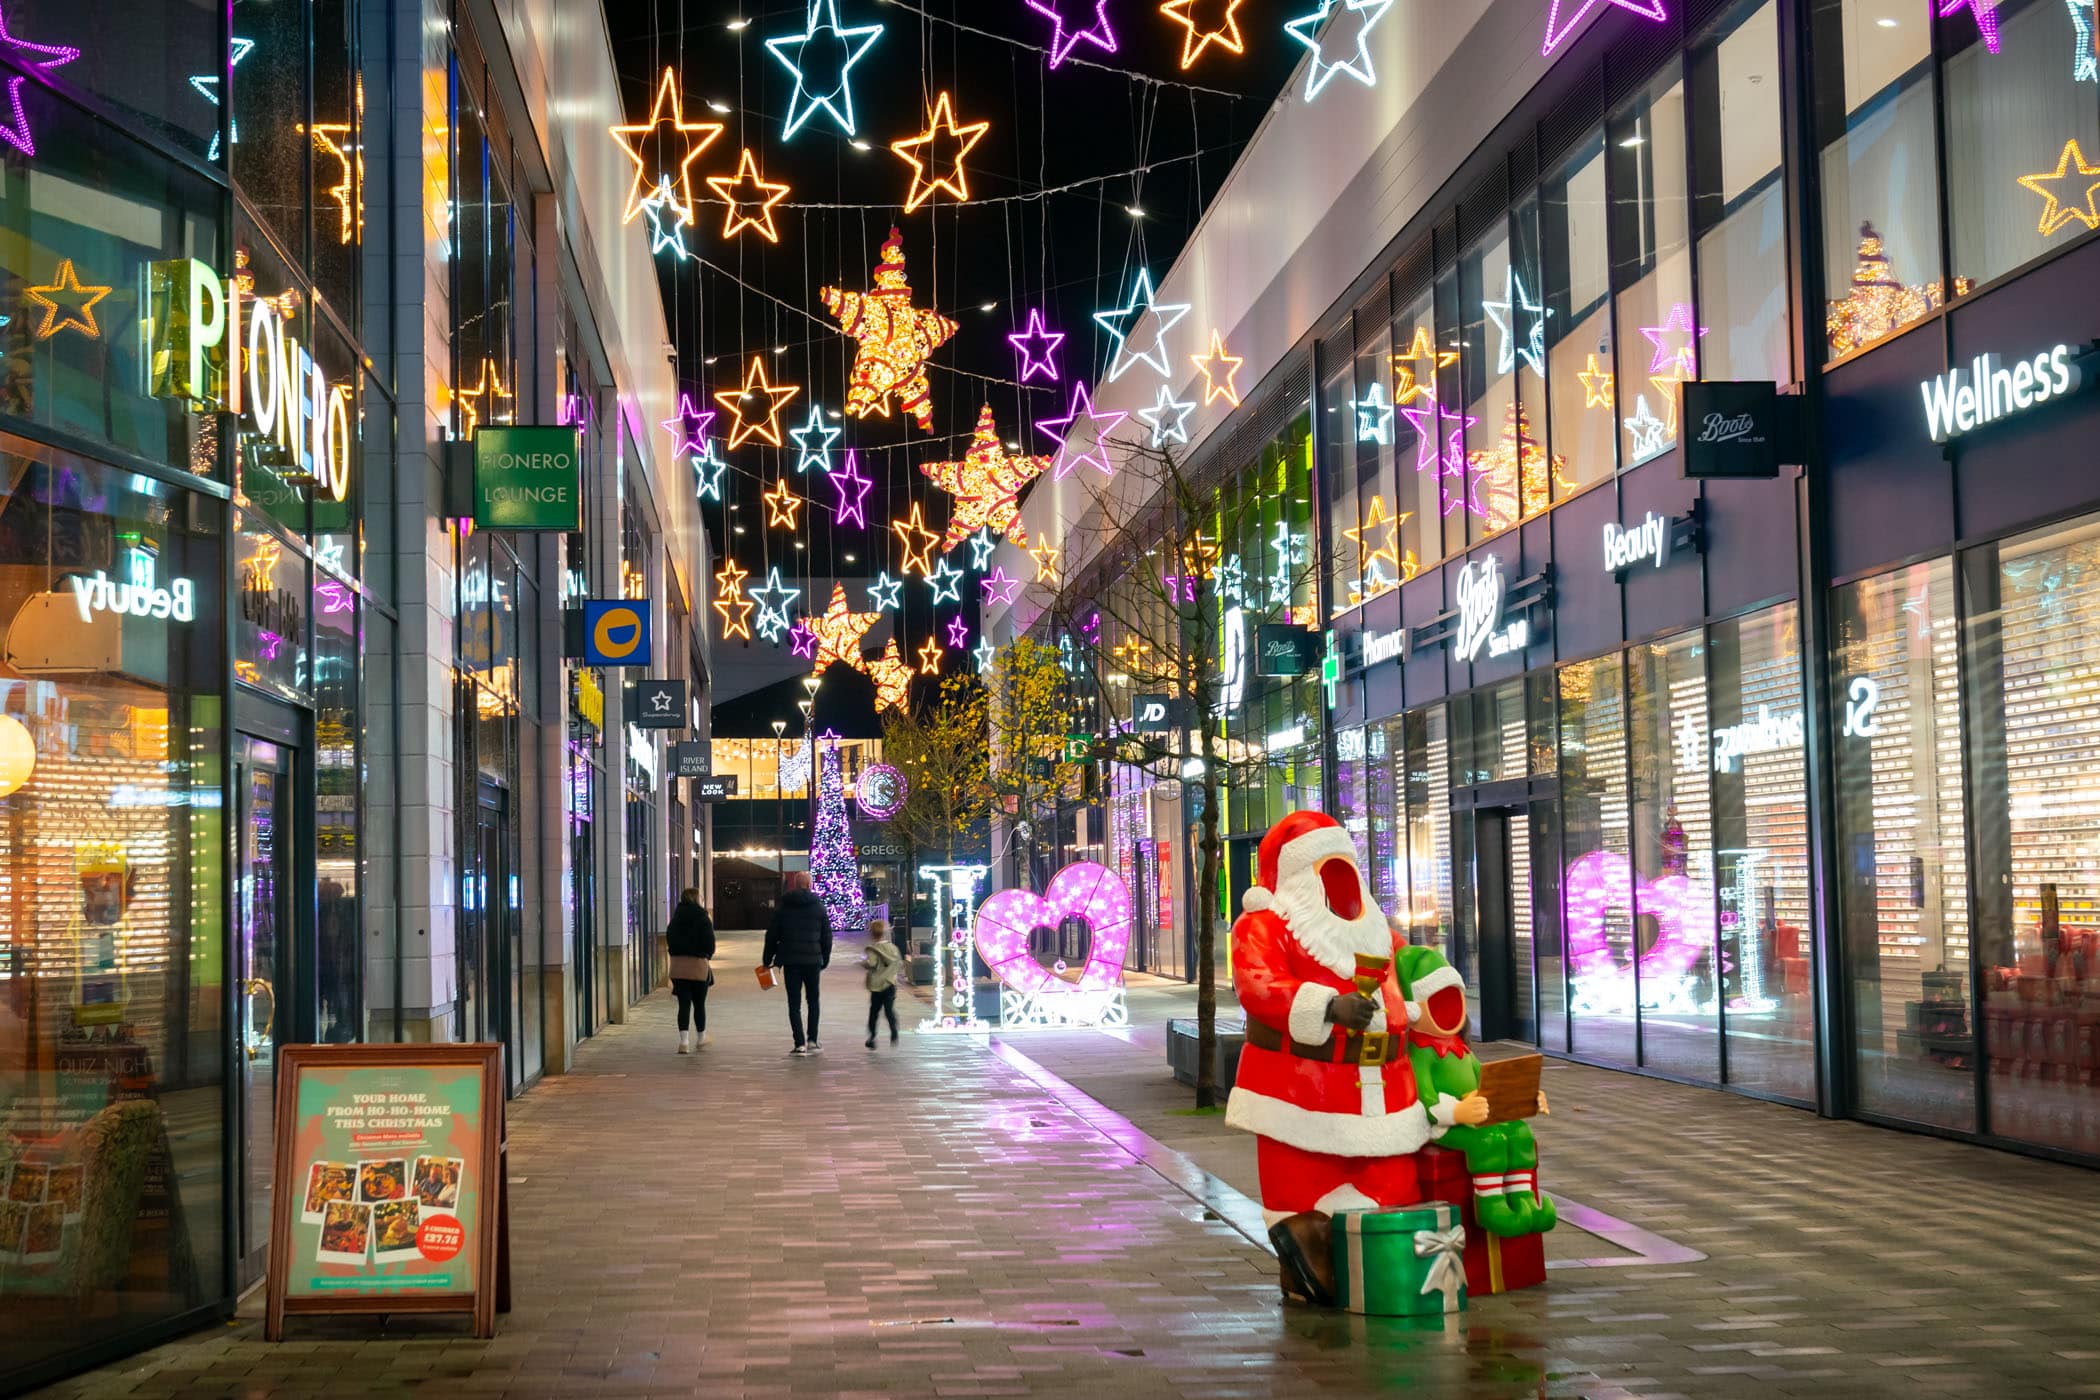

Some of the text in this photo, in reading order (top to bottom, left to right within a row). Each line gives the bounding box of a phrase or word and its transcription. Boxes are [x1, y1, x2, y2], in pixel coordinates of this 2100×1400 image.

[189, 257, 349, 502] PIONERO
[1921, 344, 2070, 441] Wellness
[1697, 412, 1754, 442] Boots
[482, 453, 570, 469] PIONERO
[484, 486, 567, 502] LOUNGE
[1603, 511, 1664, 572] Beauty
[1455, 553, 1498, 663] Boots
[1265, 640, 1296, 657] Boots
[1139, 703, 1166, 722] JD
[683, 756, 705, 764] RIVER
[680, 765, 709, 773] ISLAND
[59, 1058, 97, 1077] QUIZ
[353, 1093, 427, 1103] YOUR HOME
[327, 1107, 364, 1116] FROM
[335, 1117, 443, 1129] THIS CHRISTMAS
